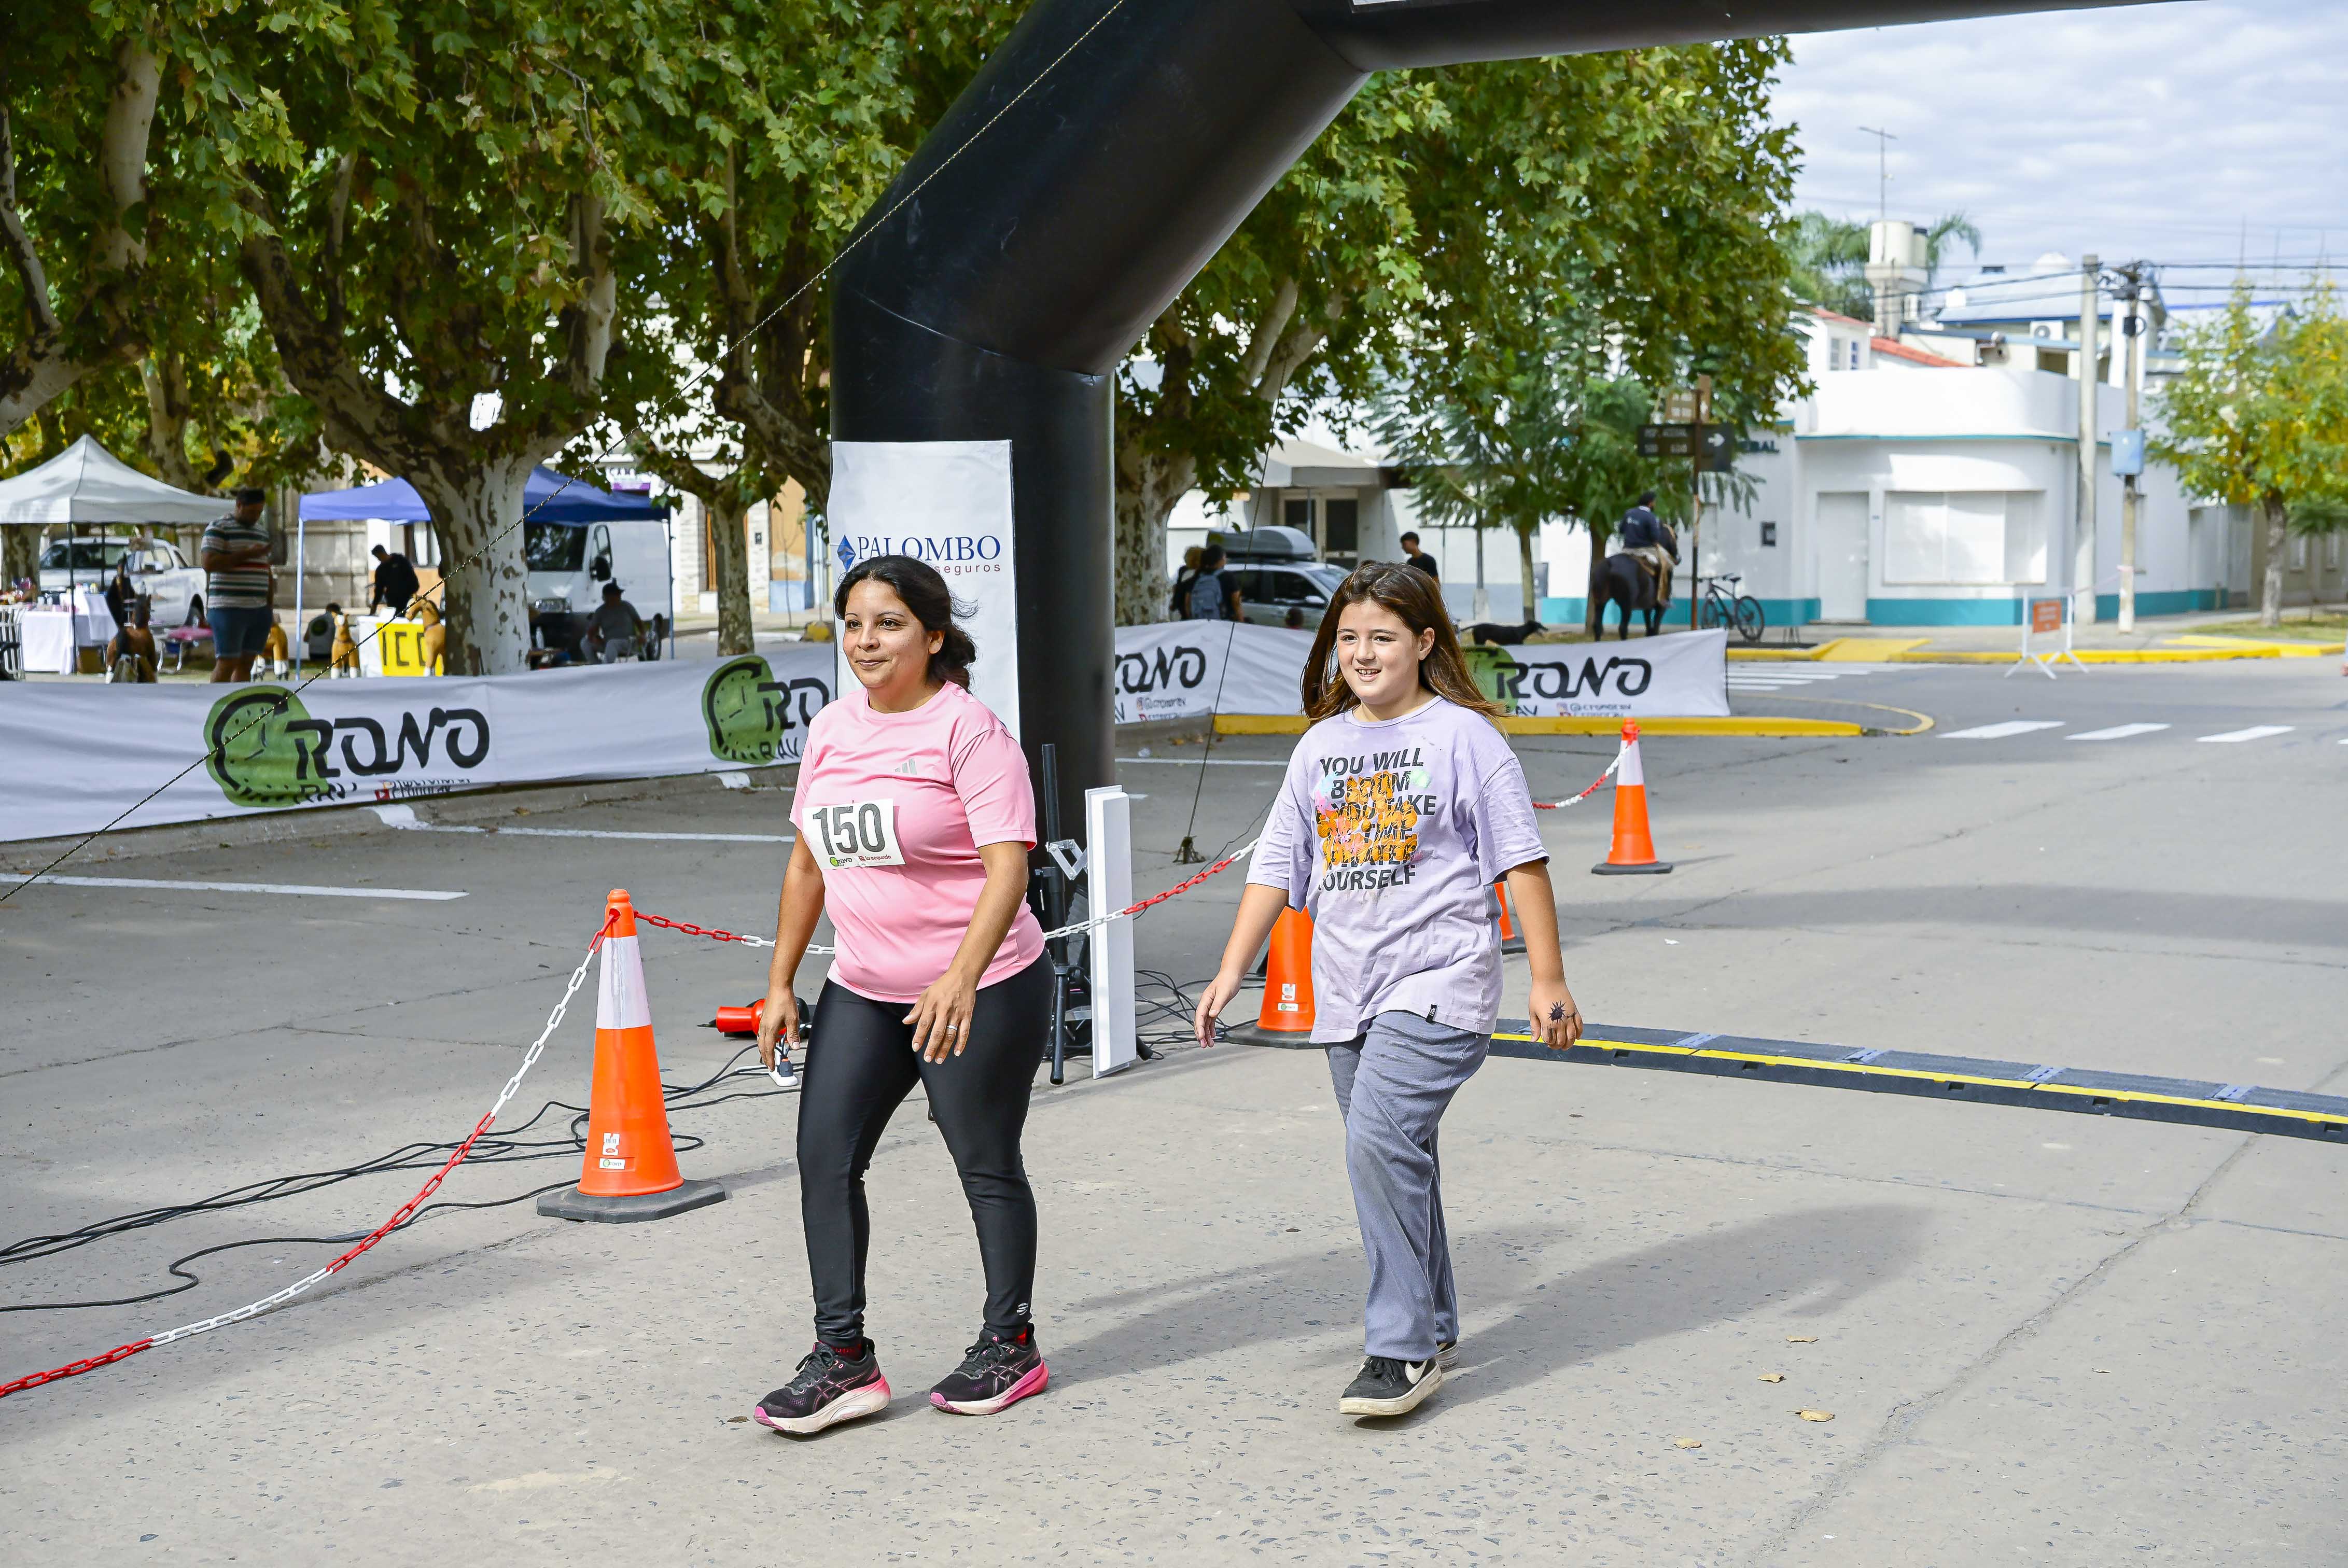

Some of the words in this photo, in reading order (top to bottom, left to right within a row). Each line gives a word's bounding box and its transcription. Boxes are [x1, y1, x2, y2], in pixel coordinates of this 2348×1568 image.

[857, 535, 1001, 561] PALOMBO
[934, 564, 1001, 576] seguros
[1320, 755, 1365, 777] YOU
[1373, 748, 1423, 772] WILL
[813, 803, 886, 856] 150
[1318, 864, 1416, 891] OURSELF
